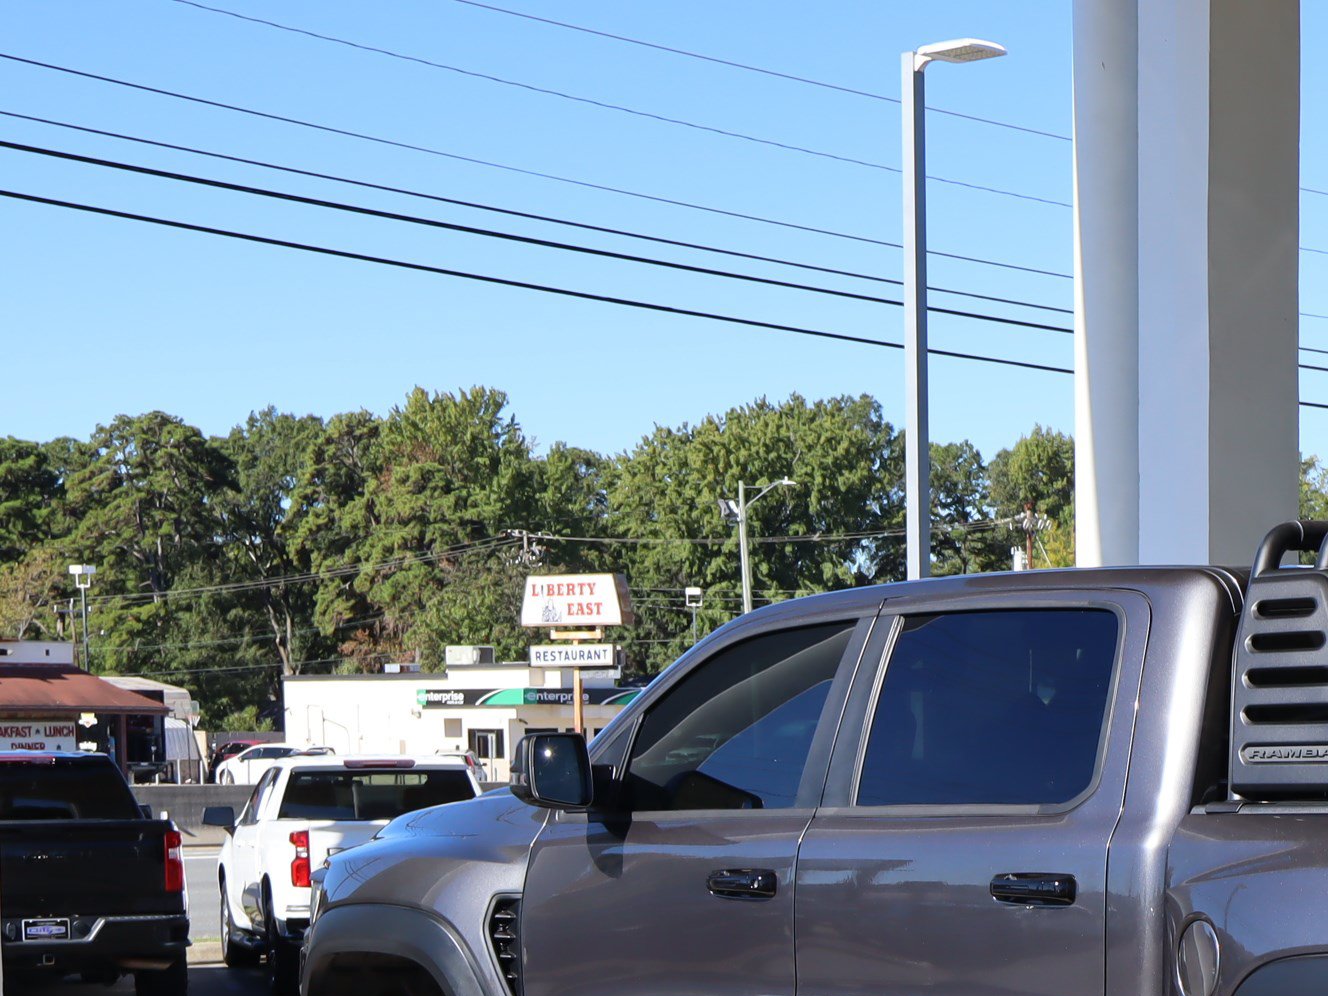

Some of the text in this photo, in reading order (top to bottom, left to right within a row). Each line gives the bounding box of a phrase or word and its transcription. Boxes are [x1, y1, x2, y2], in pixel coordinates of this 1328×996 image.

[532, 583, 596, 597] LIBERTY
[567, 602, 603, 616] EAST
[535, 649, 608, 662] RESTAURANT
[417, 690, 465, 704] enterprise
[525, 691, 589, 704] enterpre
[44, 726, 74, 737] LUNCH
